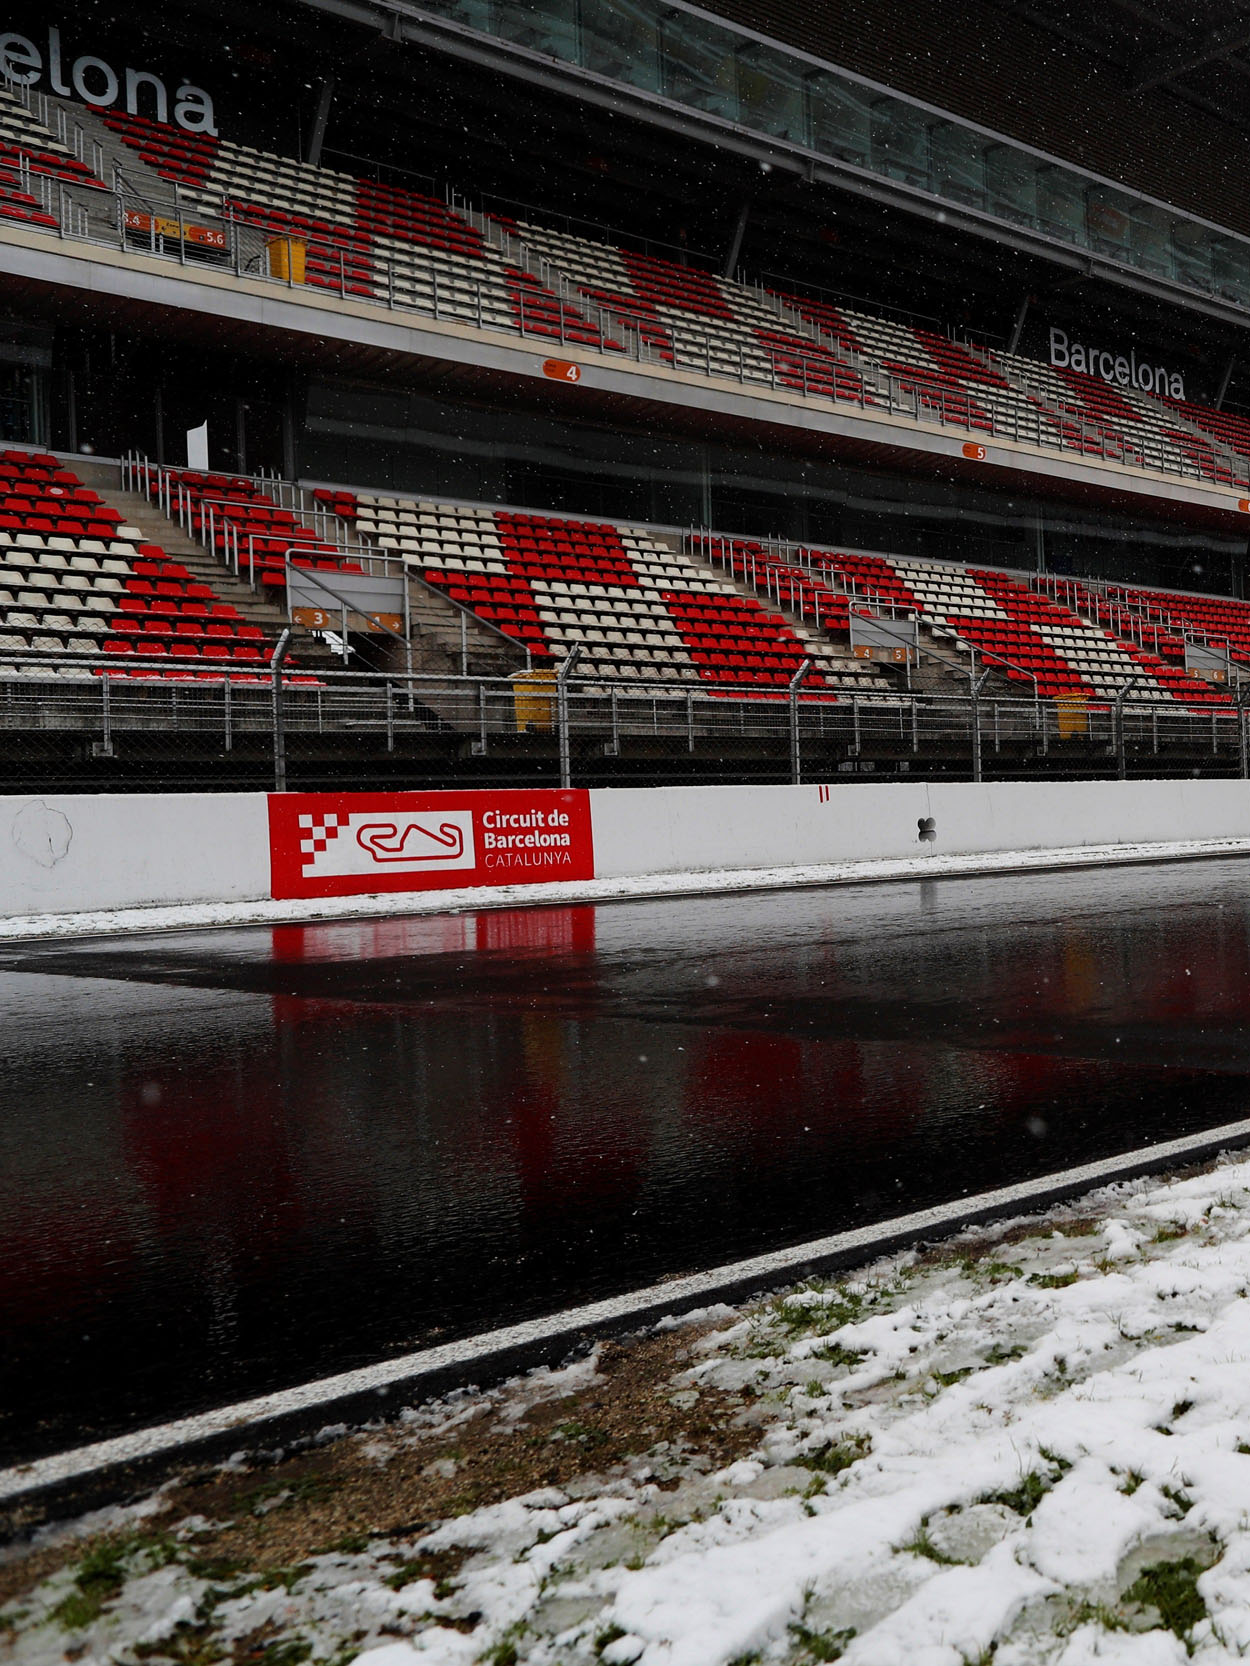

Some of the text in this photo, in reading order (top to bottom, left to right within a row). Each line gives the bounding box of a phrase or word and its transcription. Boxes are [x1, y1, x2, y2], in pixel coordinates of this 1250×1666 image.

[206, 232, 224, 245] 5.6
[1050, 326, 1186, 400] Barcelona
[566, 366, 577, 380] 4
[977, 447, 984, 459] 5
[313, 612, 323, 625] 3
[864, 649, 870, 658] 4
[895, 650, 902, 660] 5
[482, 808, 569, 829] Circuit de
[484, 830, 571, 849] Barcelona
[485, 851, 572, 868] CATALUNYA
